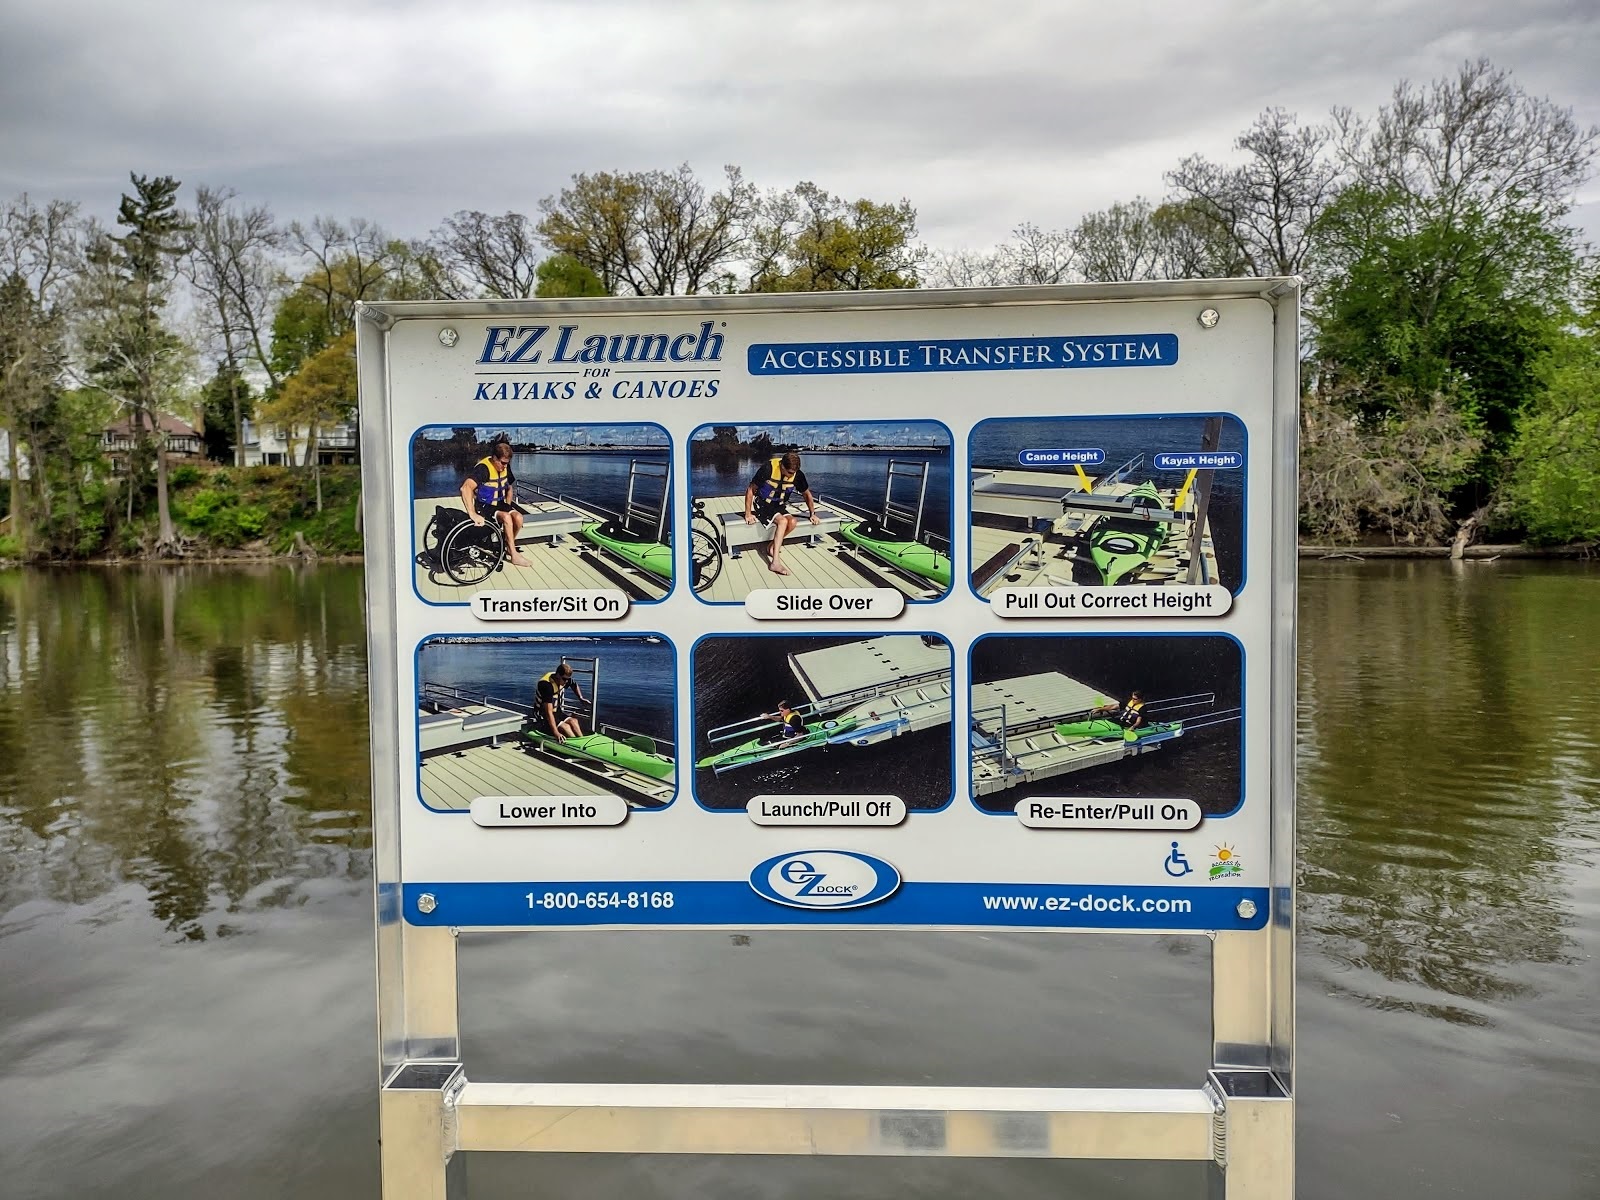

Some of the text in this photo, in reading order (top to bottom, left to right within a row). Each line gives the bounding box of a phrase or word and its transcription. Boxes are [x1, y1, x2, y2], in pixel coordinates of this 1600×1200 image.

[475, 324, 550, 365] EZ
[760, 341, 1163, 370] ACCESSIBLE TRANSFER SYSTEM
[583, 368, 610, 378] FOR
[473, 379, 720, 401] KAYAKS & CANOES
[1025, 451, 1099, 463] Canoe Height
[1161, 455, 1236, 467] Kayak Height
[479, 596, 619, 613] Transfer/Sit On
[776, 594, 874, 611] Slide Over
[1005, 592, 1212, 611] Pull Out Correct Height
[499, 803, 597, 819] Lower Into
[761, 801, 891, 817] Launch/Pull Off
[1030, 803, 1188, 821] Re-Enter/Pull On
[1208, 871, 1241, 882] recreation
[525, 892, 675, 909] 1-800-654-8168
[983, 894, 1192, 913] www.ez-dock.com
